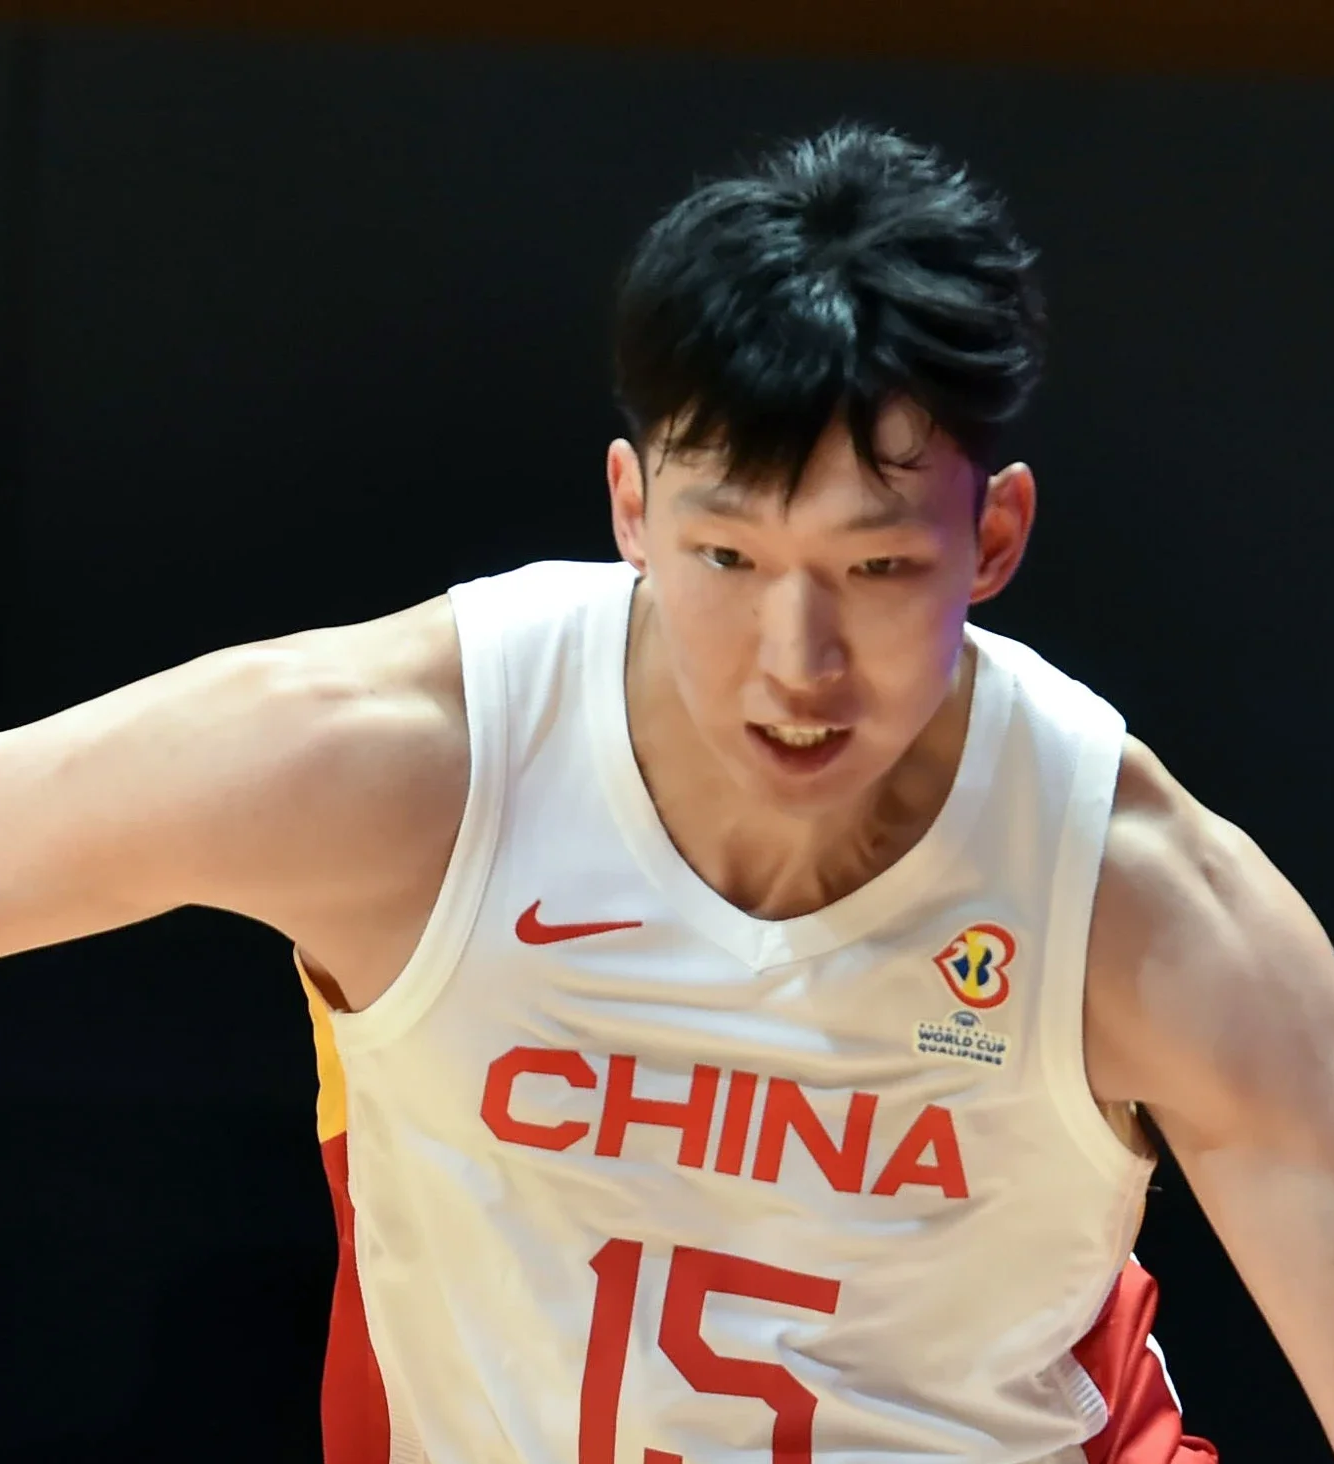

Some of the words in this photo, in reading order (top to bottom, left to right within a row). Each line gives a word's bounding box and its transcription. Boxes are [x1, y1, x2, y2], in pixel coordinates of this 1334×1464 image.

[918, 1029, 973, 1048] WORLD
[976, 1039, 1006, 1053] CUP
[918, 1043, 1002, 1065] QUALIFIERS
[480, 1046, 969, 1198] CHINA
